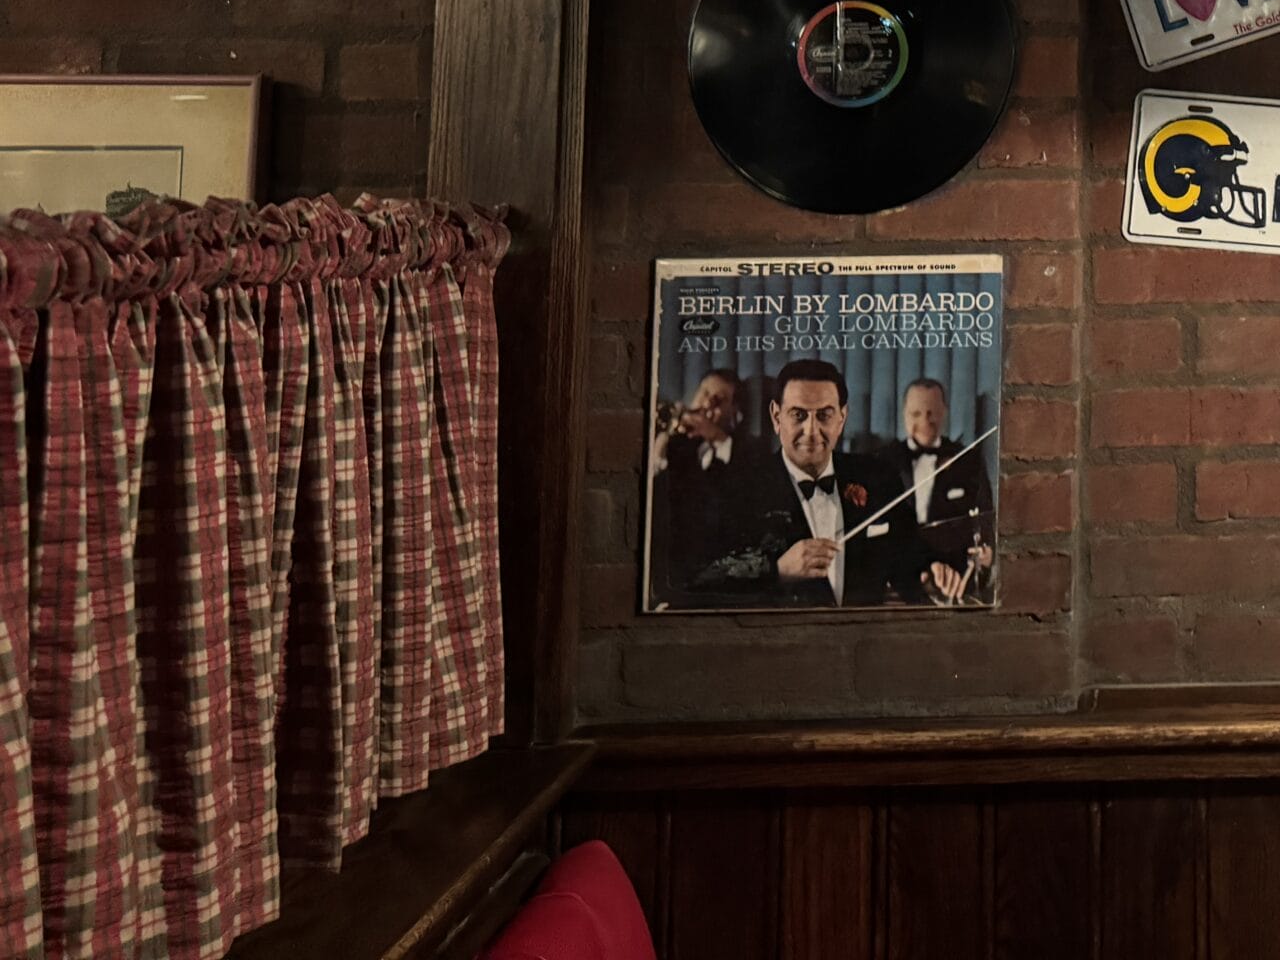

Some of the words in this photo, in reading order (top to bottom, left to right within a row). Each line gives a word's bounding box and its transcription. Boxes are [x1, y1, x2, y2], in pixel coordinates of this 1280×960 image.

[1232, 21, 1253, 36] The
[699, 265, 733, 273] CAPITOL
[737, 261, 835, 277] STEREO
[854, 264, 873, 272] FULL
[875, 264, 915, 272] SPECTRUM
[930, 263, 957, 271] SOUND
[678, 294, 785, 316] BERLIN
[793, 294, 830, 315] BY
[838, 291, 994, 314] LOMBARDO
[773, 314, 831, 334] GUY
[840, 312, 994, 333] LOMBARDO
[678, 335, 728, 354] AND
[734, 334, 776, 352] HIS
[783, 333, 855, 351] ROYAL
[861, 331, 994, 350] CANADIANS
